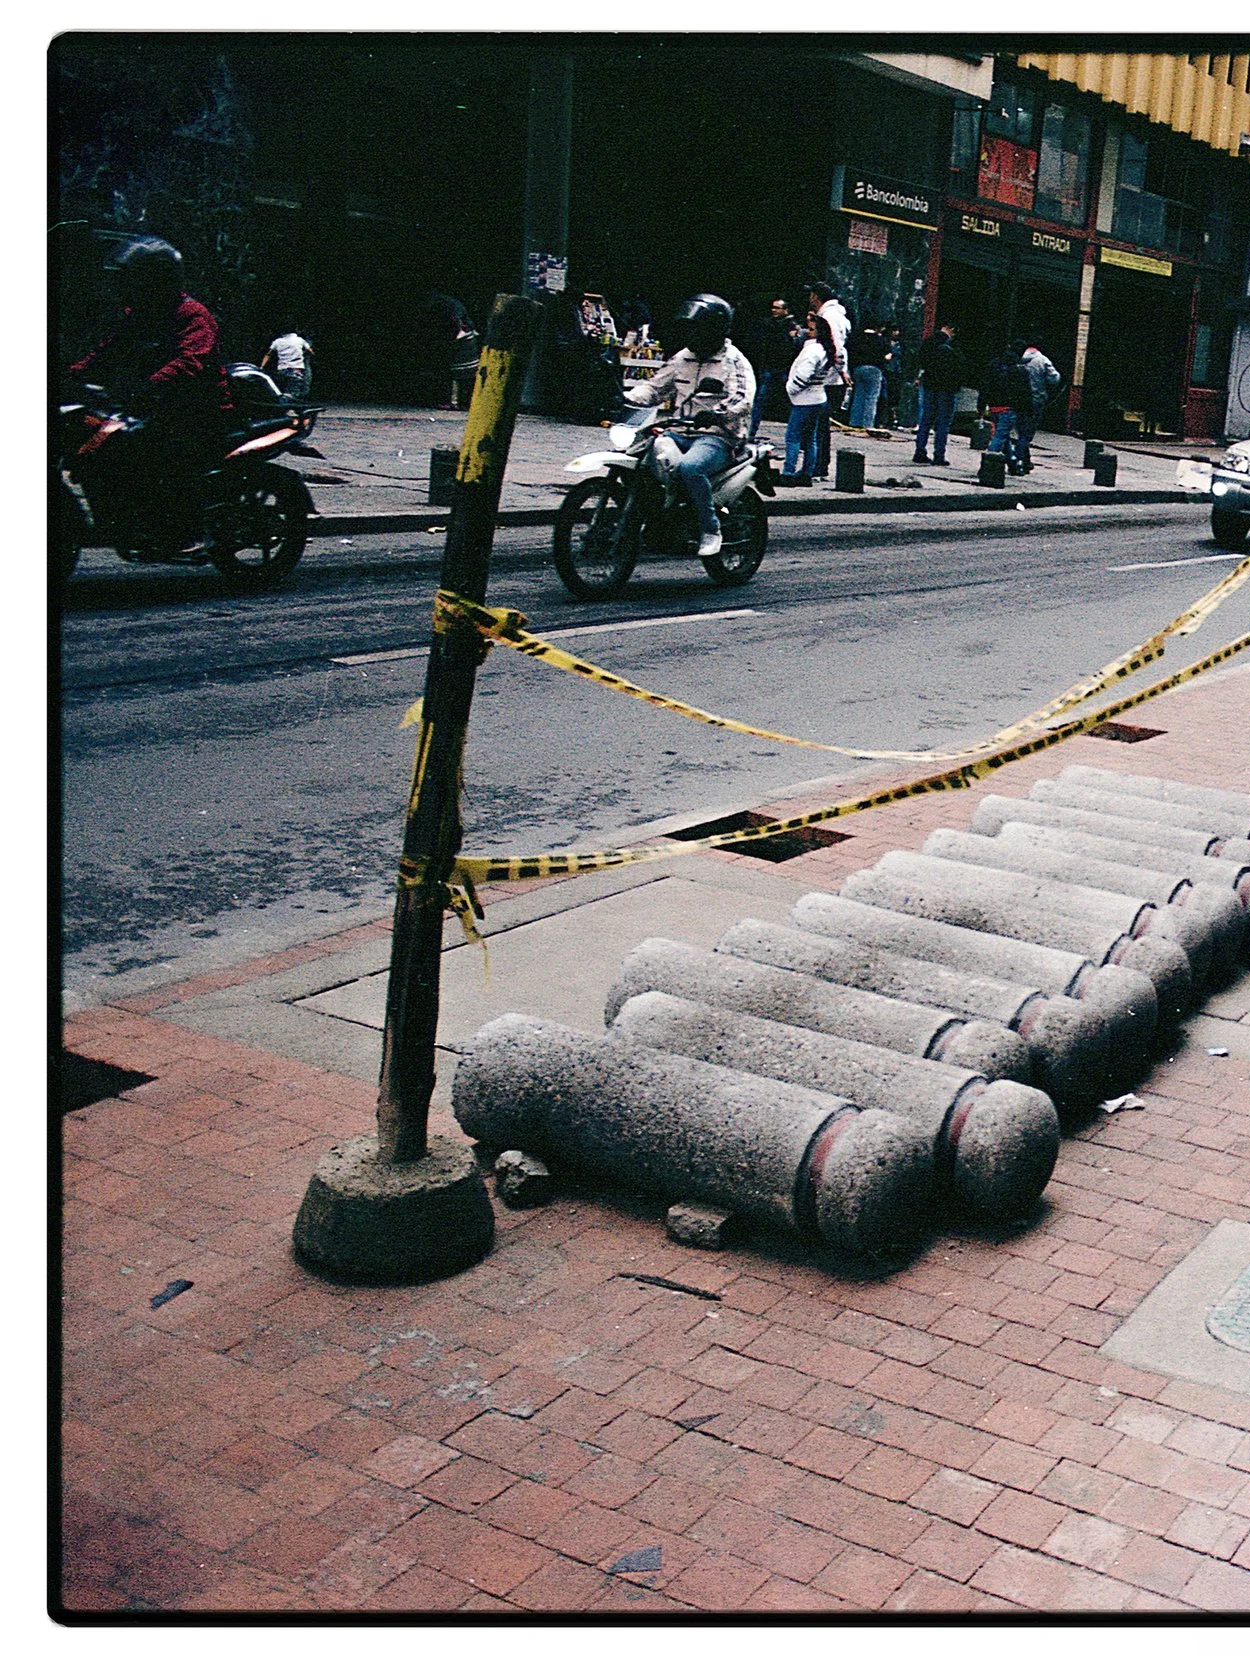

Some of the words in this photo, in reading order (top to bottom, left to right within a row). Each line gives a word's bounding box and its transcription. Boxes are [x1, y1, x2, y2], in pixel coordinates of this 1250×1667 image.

[866, 184, 929, 213] Bancolombia
[961, 214, 1001, 237] SALIDA
[1032, 231, 1071, 254] ENTRADA
